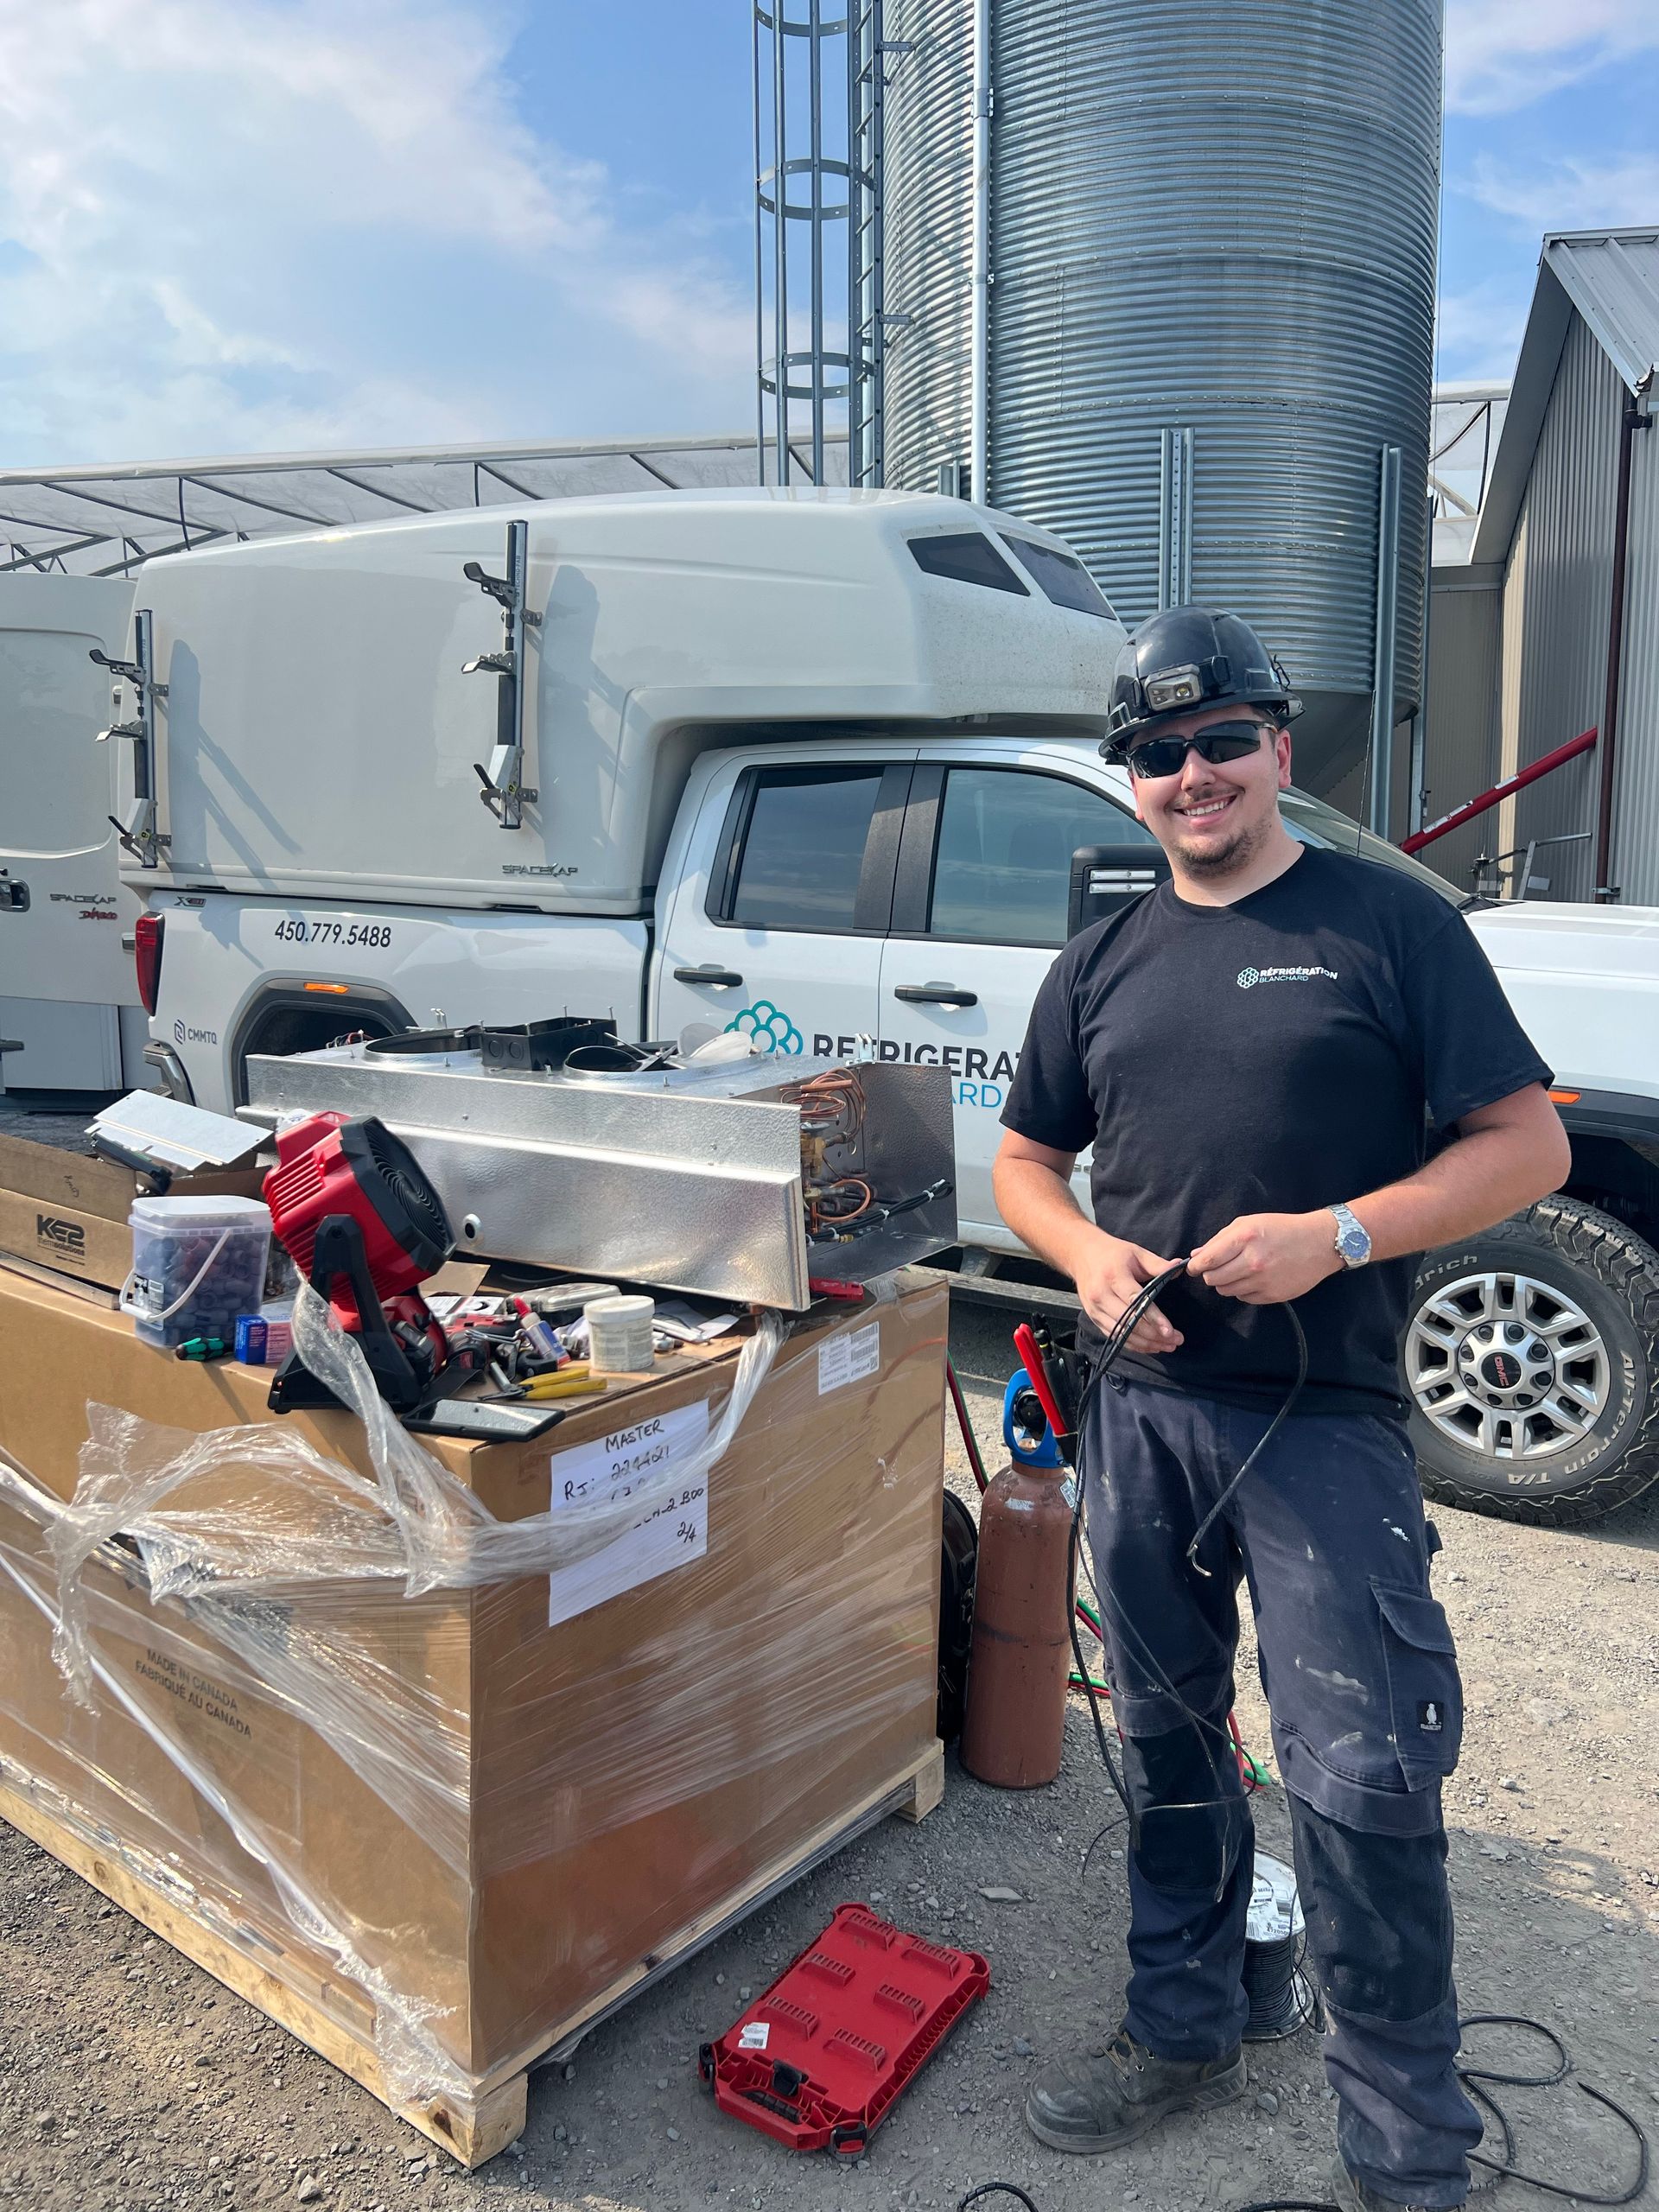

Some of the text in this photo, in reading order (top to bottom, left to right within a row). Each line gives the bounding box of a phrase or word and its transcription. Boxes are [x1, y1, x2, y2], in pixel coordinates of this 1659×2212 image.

[274, 919, 392, 949] 450.779.5488
[1258, 975, 1309, 983] BLANCHARD
[1259, 966, 1338, 980] RÉFRIGÉRATION
[188, 1027, 218, 1046] CMMTQ
[813, 1033, 1020, 1083] RERIGERA
[36, 1213, 85, 1249] KE2
[1493, 1355, 1510, 1388] GMC
[605, 1419, 664, 1453] MASTER
[1507, 1471, 1552, 1485] T/A
[147, 1649, 238, 1710] MADE IN CANADA
[135, 1660, 251, 1738] FABRIQUÉ AU CANADA
